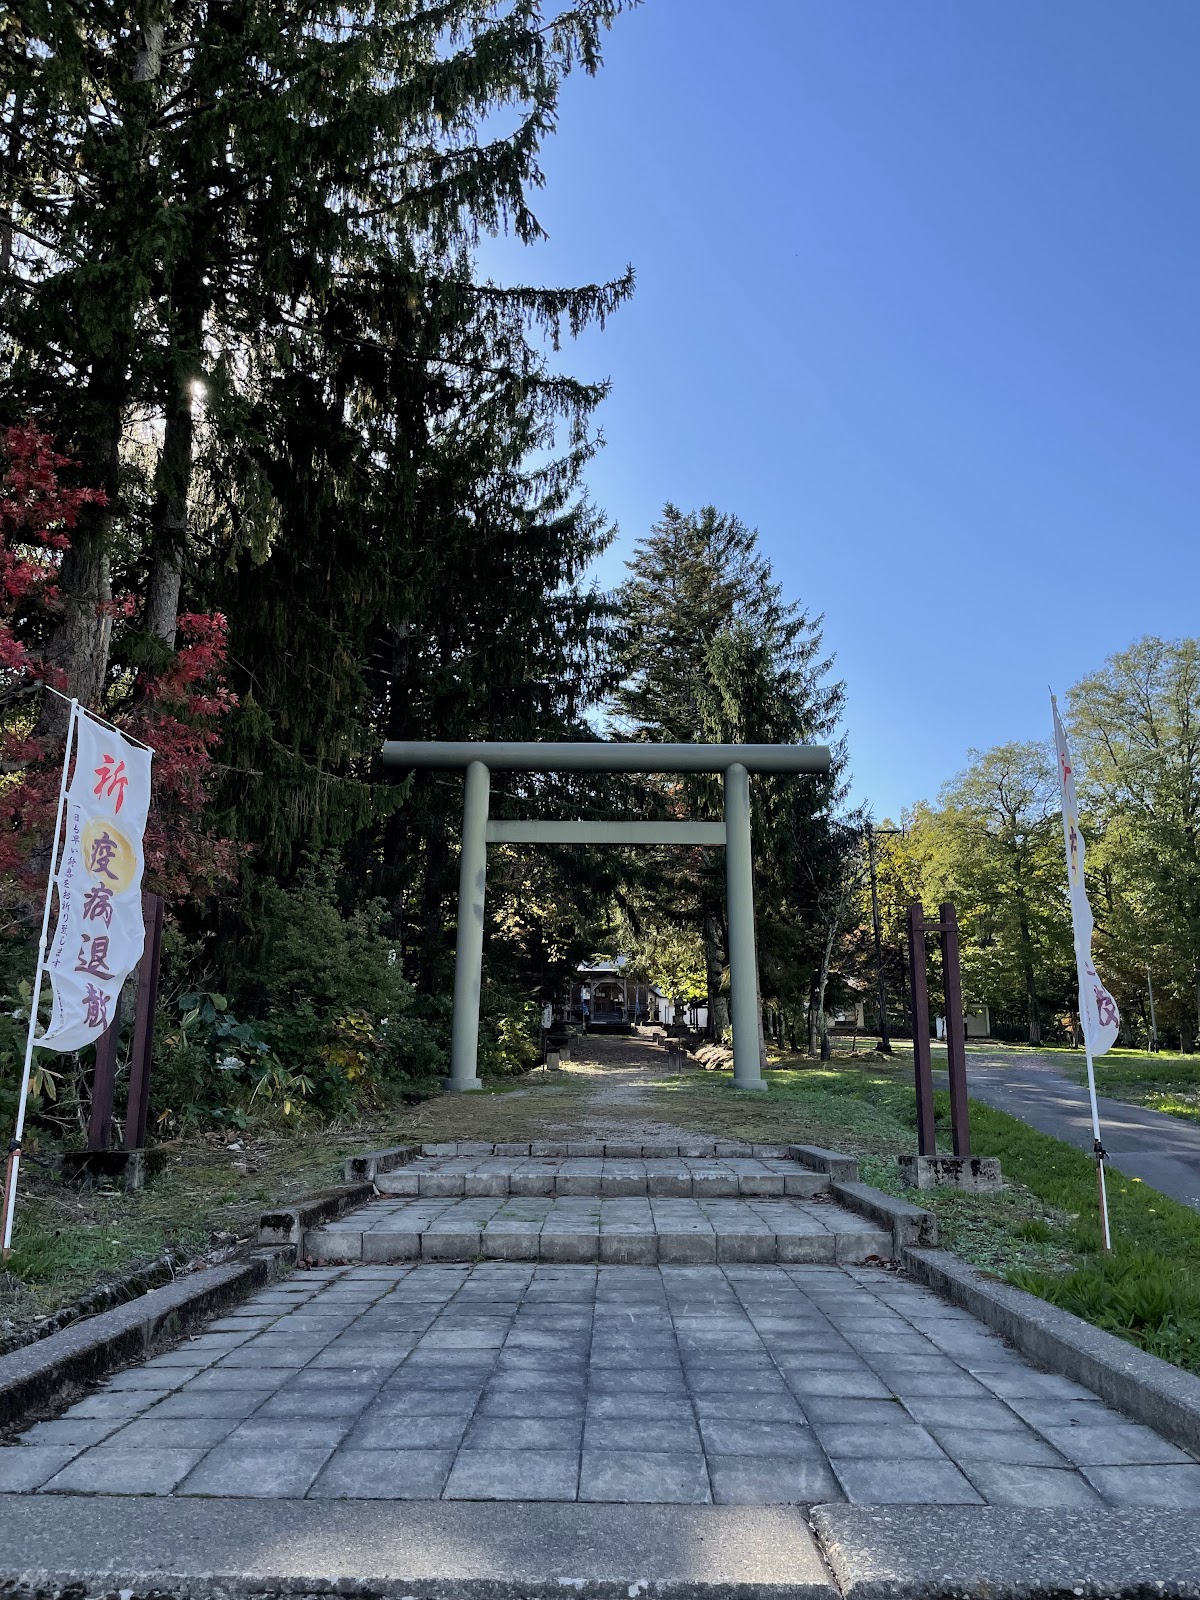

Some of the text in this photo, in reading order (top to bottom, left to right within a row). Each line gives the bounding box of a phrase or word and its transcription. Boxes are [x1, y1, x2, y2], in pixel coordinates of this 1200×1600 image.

[93, 754, 129, 815] 祈
[74, 831, 119, 1030] 疫病退散
